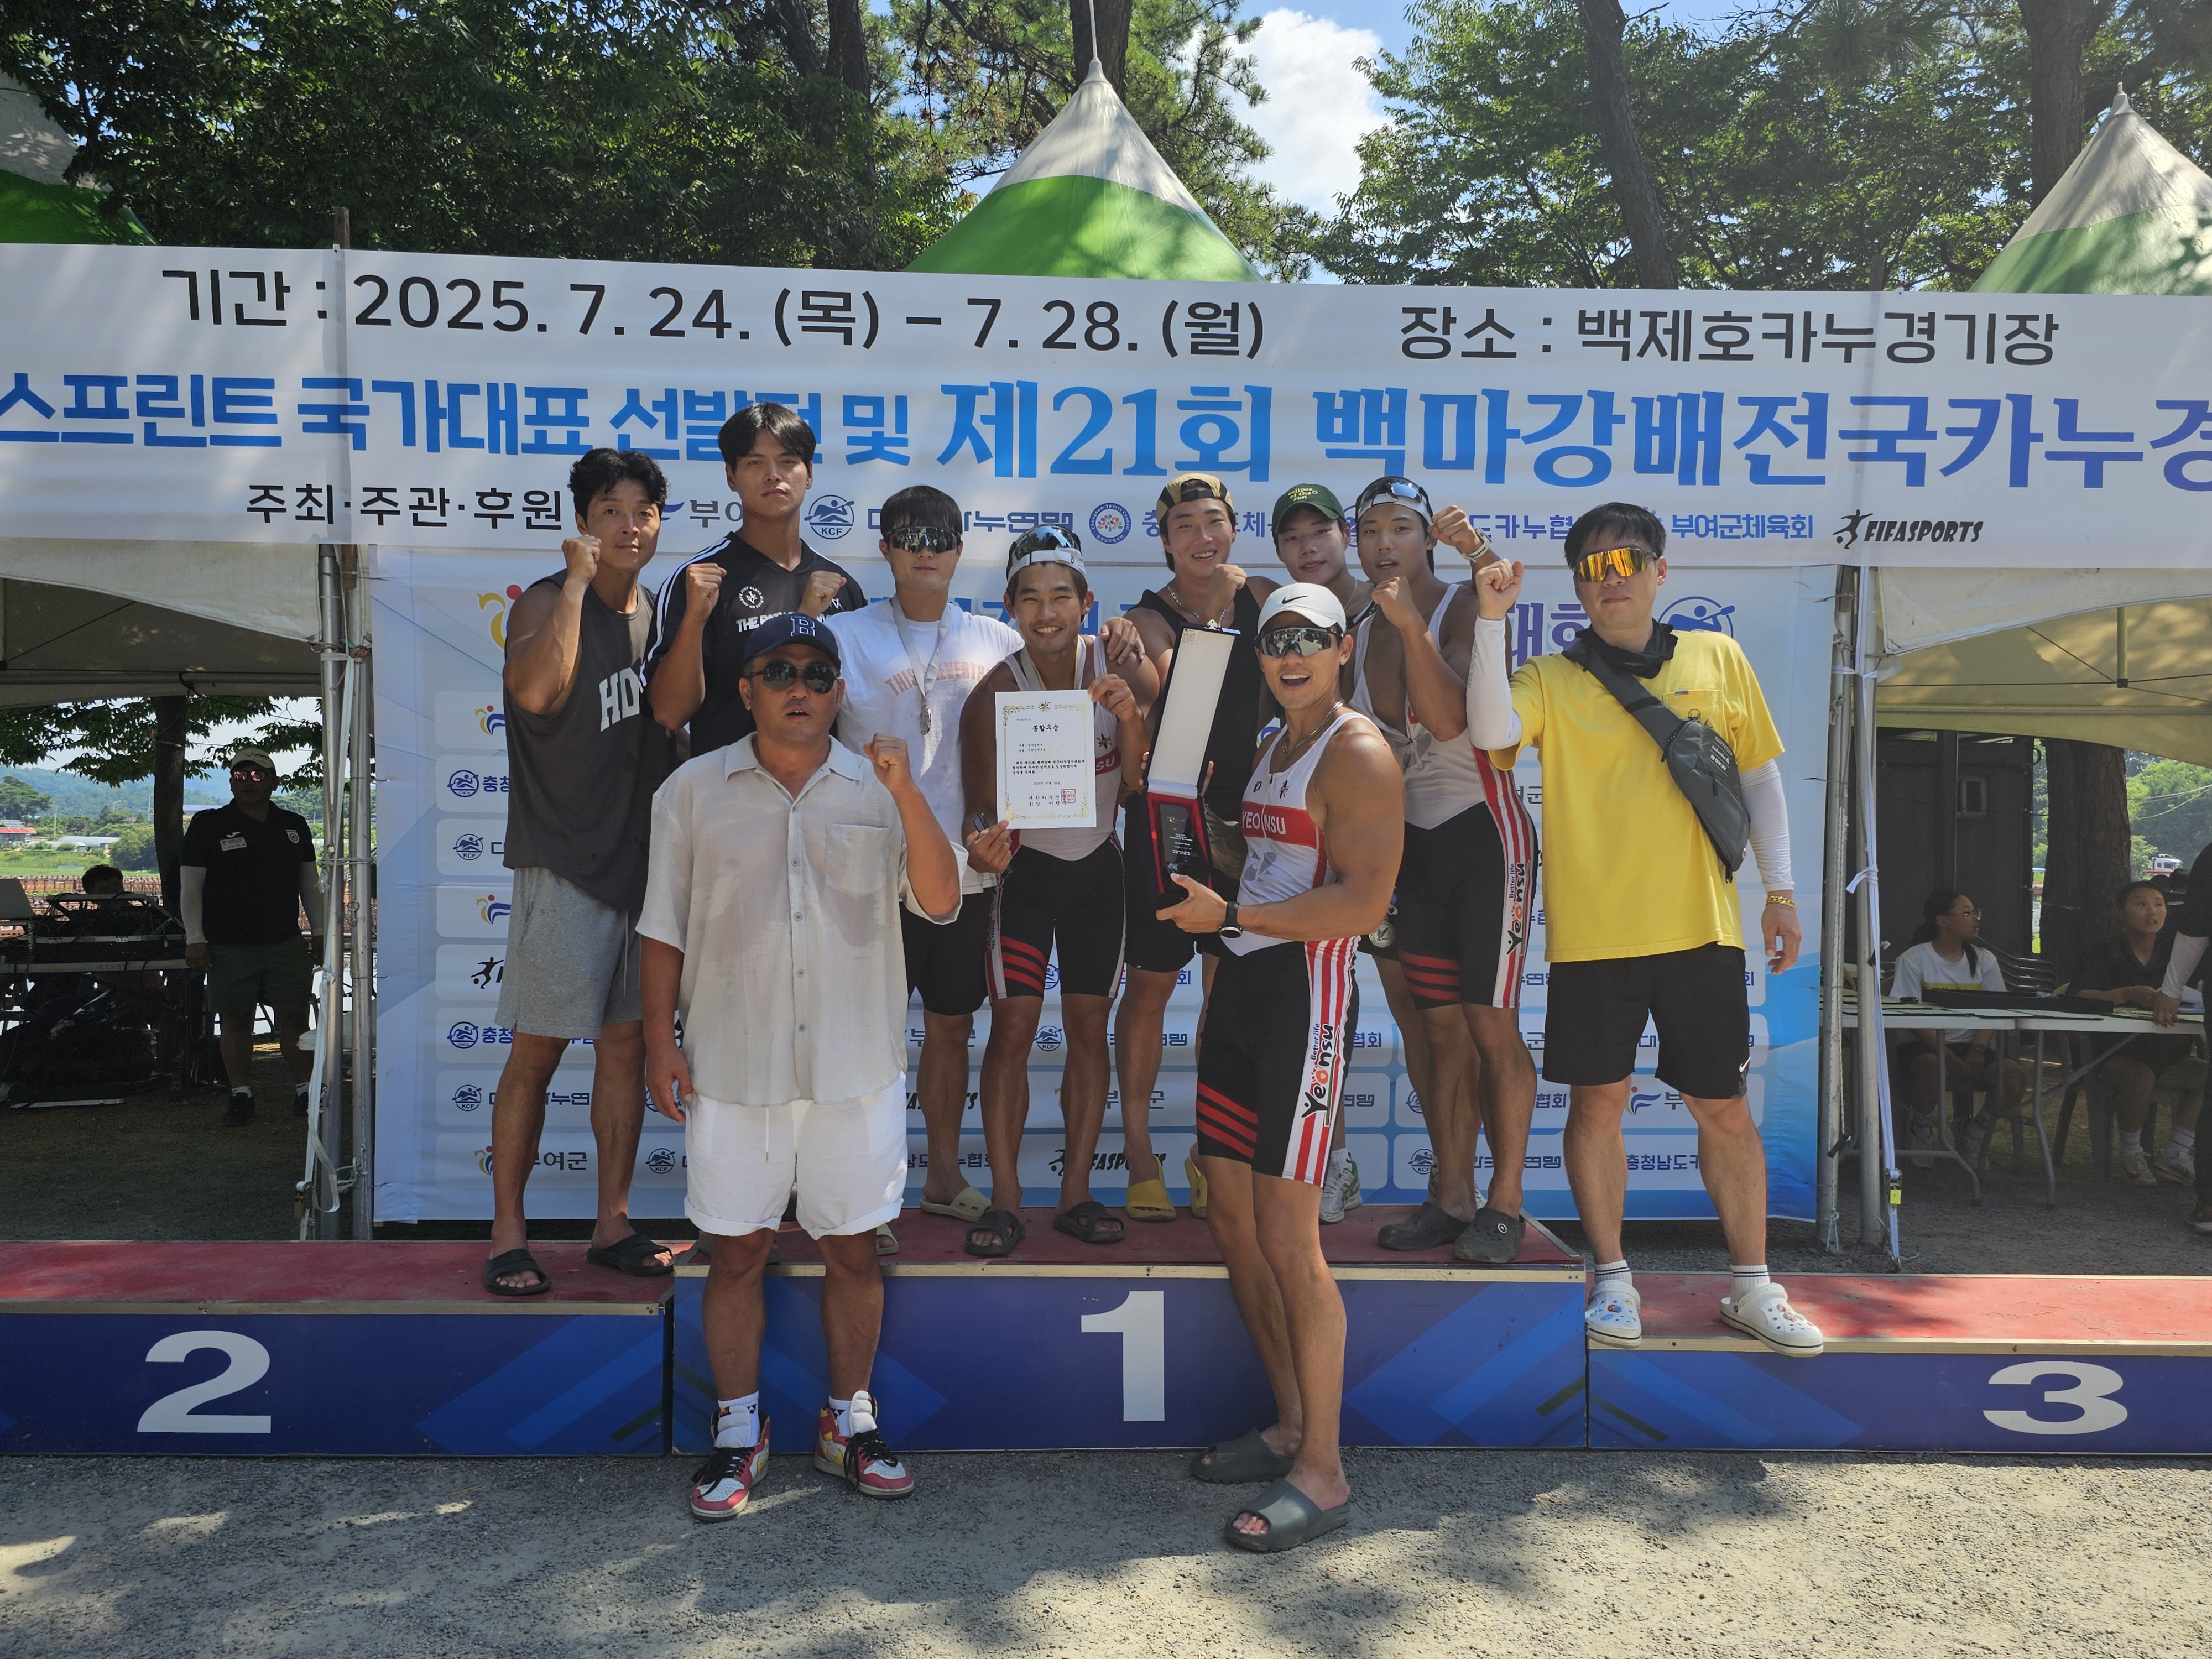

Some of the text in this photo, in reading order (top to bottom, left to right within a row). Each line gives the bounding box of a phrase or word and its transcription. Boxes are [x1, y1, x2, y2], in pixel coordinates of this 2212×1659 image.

[162, 269, 290, 326] 기간
[353, 274, 547, 332] 2025.
[570, 284, 624, 335] 7.
[649, 287, 749, 340] 24.
[775, 288, 879, 349] (목)
[967, 298, 1018, 348] 7.
[1042, 300, 1138, 351] 28.
[1162, 300, 1264, 360] (월)
[1401, 306, 1517, 359] 장소
[1577, 308, 2060, 366] 백제호카누경기장
[0, 372, 282, 448] 스프린트
[297, 376, 593, 456] 국가대표
[842, 395, 911, 466] 및
[937, 380, 1272, 482] 제21회
[821, 527, 842, 536] KCF
[1671, 514, 1813, 540] 부여군체육회
[1864, 520, 1984, 544] FIFASPORTS
[736, 617, 759, 632] THE
[791, 615, 816, 637] B
[1242, 811, 1286, 835] YEONSU
[1506, 863, 1525, 955] Yeonsu
[1310, 1037, 1319, 1060] Better
[1302, 1024, 1333, 1118] Yeonsu
[533, 1152, 587, 1171] 여군
[1081, 1290, 1165, 1421] 1
[137, 1330, 271, 1433] 2
[1983, 1361, 2128, 1435] 3
